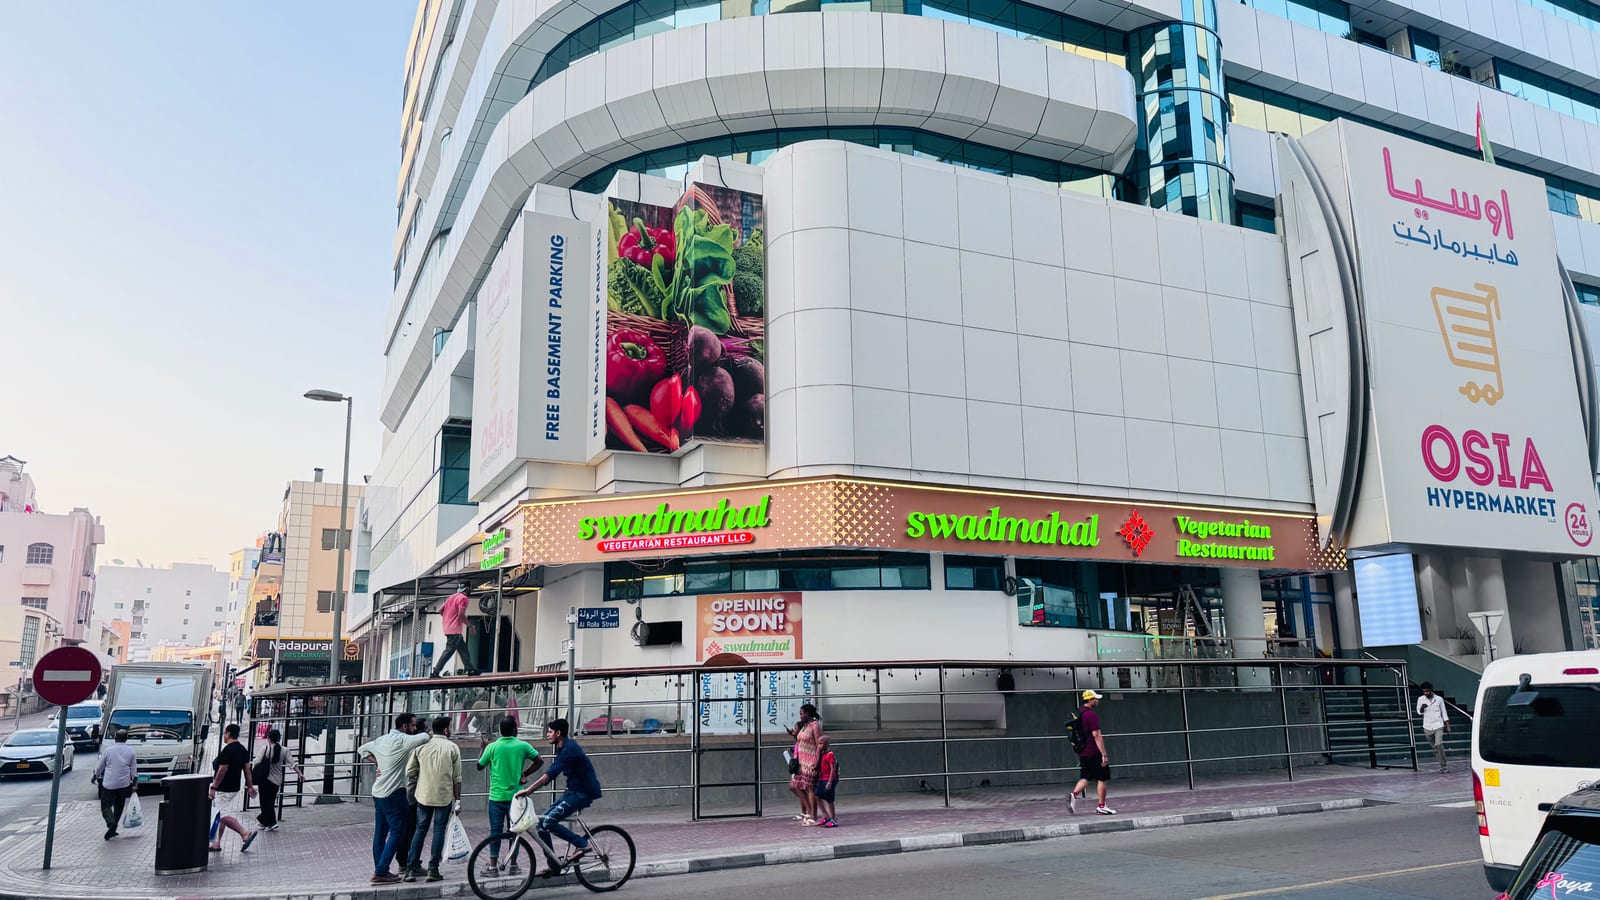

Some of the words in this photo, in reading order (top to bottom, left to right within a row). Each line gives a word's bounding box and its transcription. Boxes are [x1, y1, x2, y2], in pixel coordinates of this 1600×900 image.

[1393, 221, 1518, 266] هايبرماركت
[549, 235, 564, 308] PARKING
[547, 313, 561, 398] BASEMENT
[546, 404, 560, 440] FREE
[1421, 424, 1553, 492] OSIA
[1427, 487, 1556, 517] HYPERMARKET
[578, 495, 769, 540] swadmahal
[907, 506, 1100, 547] swadmahal
[1176, 515, 1271, 539] Vegetarian
[1570, 513, 1587, 529] 24
[603, 538, 661, 550] VEGETARIAN
[664, 534, 726, 547] RESTAURANT
[727, 533, 747, 543] LLC
[1572, 529, 1589, 537] HOURS
[1177, 539, 1275, 560] Restaurant
[601, 610, 618, 619] شارع
[711, 599, 784, 612] OPENING
[601, 620, 619, 628] Street
[713, 613, 784, 631] SOON!
[724, 639, 790, 652] swadmahal
[1536, 872, 1593, 900] Roya
